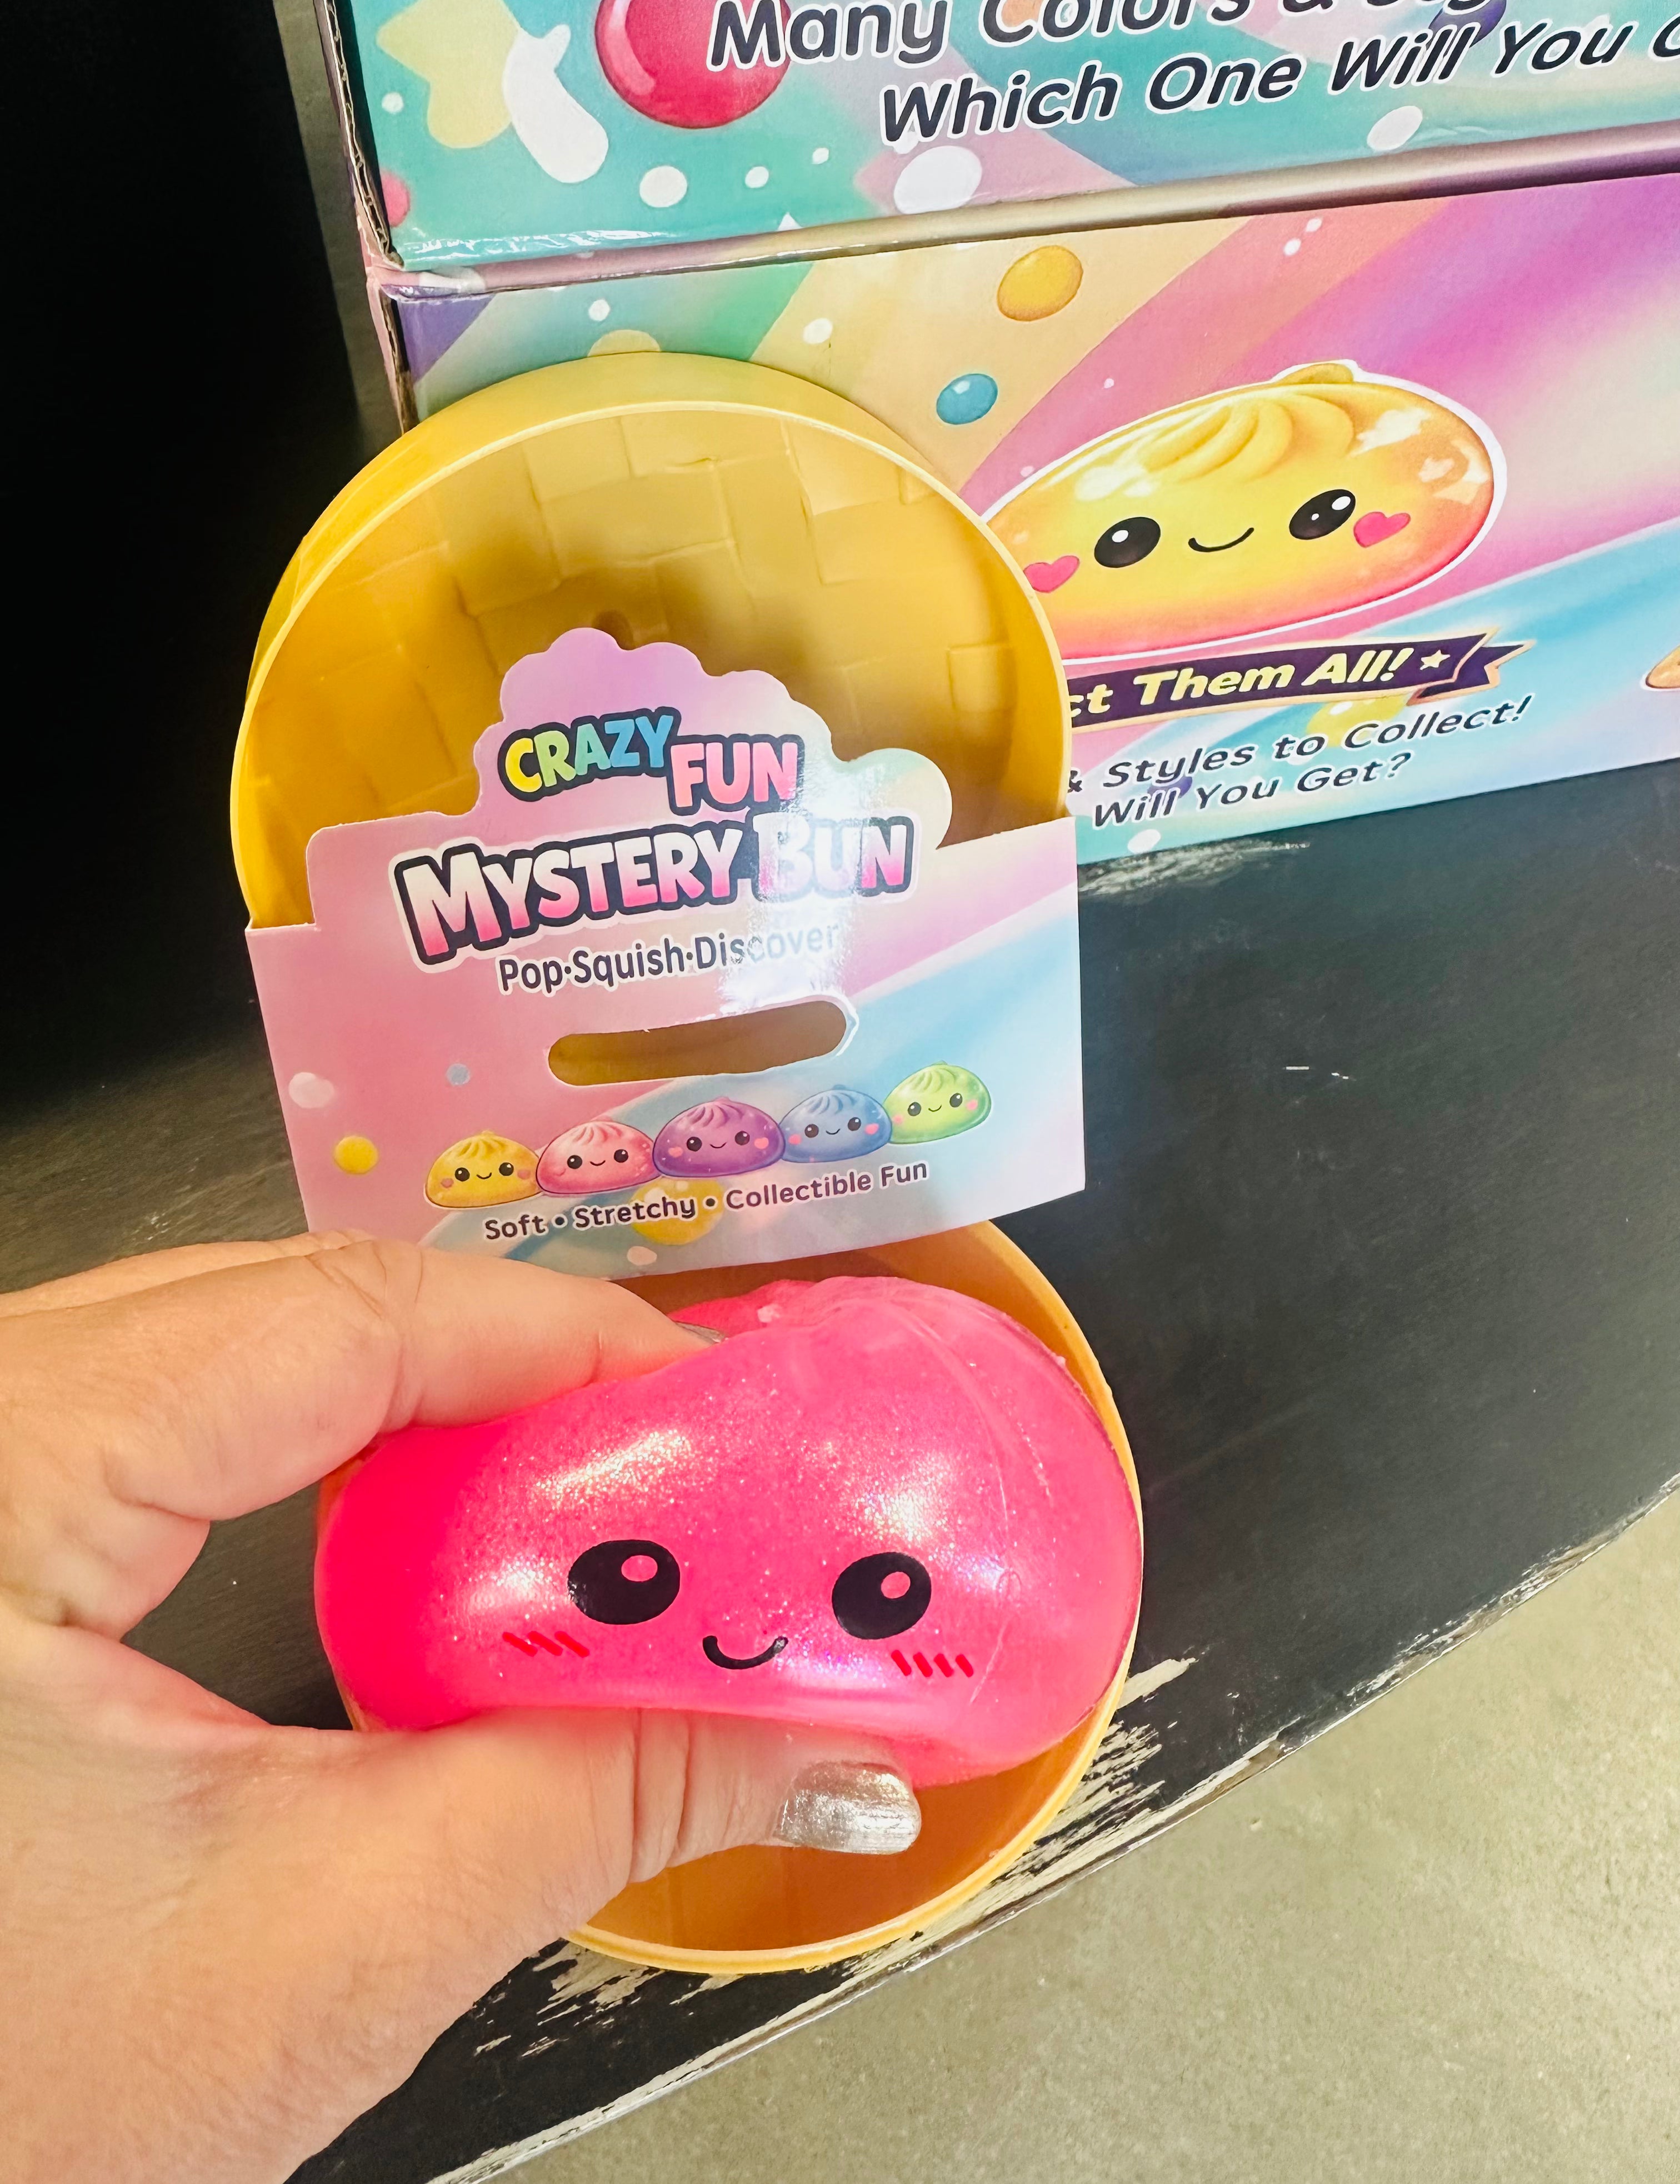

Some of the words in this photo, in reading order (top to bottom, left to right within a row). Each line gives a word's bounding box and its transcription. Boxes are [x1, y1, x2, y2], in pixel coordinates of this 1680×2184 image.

[711, 0, 949, 66] Many
[883, 64, 1117, 142] Which
[1150, 57, 1299, 109] One
[1333, 26, 1475, 92] Will
[1495, 22, 1634, 74] You
[1133, 664, 1292, 706] Them
[1306, 647, 1412, 684] All!
[504, 714, 674, 793] CRAZY
[669, 741, 799, 808] FUN
[1103, 747, 1253, 786] Styles
[1274, 733, 1325, 760] to
[1347, 694, 1531, 748] Collect!
[1095, 789, 1178, 828] Will
[1197, 772, 1279, 809] You
[1297, 754, 1412, 791] Get?
[401, 827, 744, 957] MYSTERY
[752, 811, 908, 897] BUN
[484, 1215, 546, 1242] Soft
[574, 1198, 696, 1230] Stretchy
[727, 1173, 872, 1210] Collectible
[881, 1163, 928, 1187] Fun
